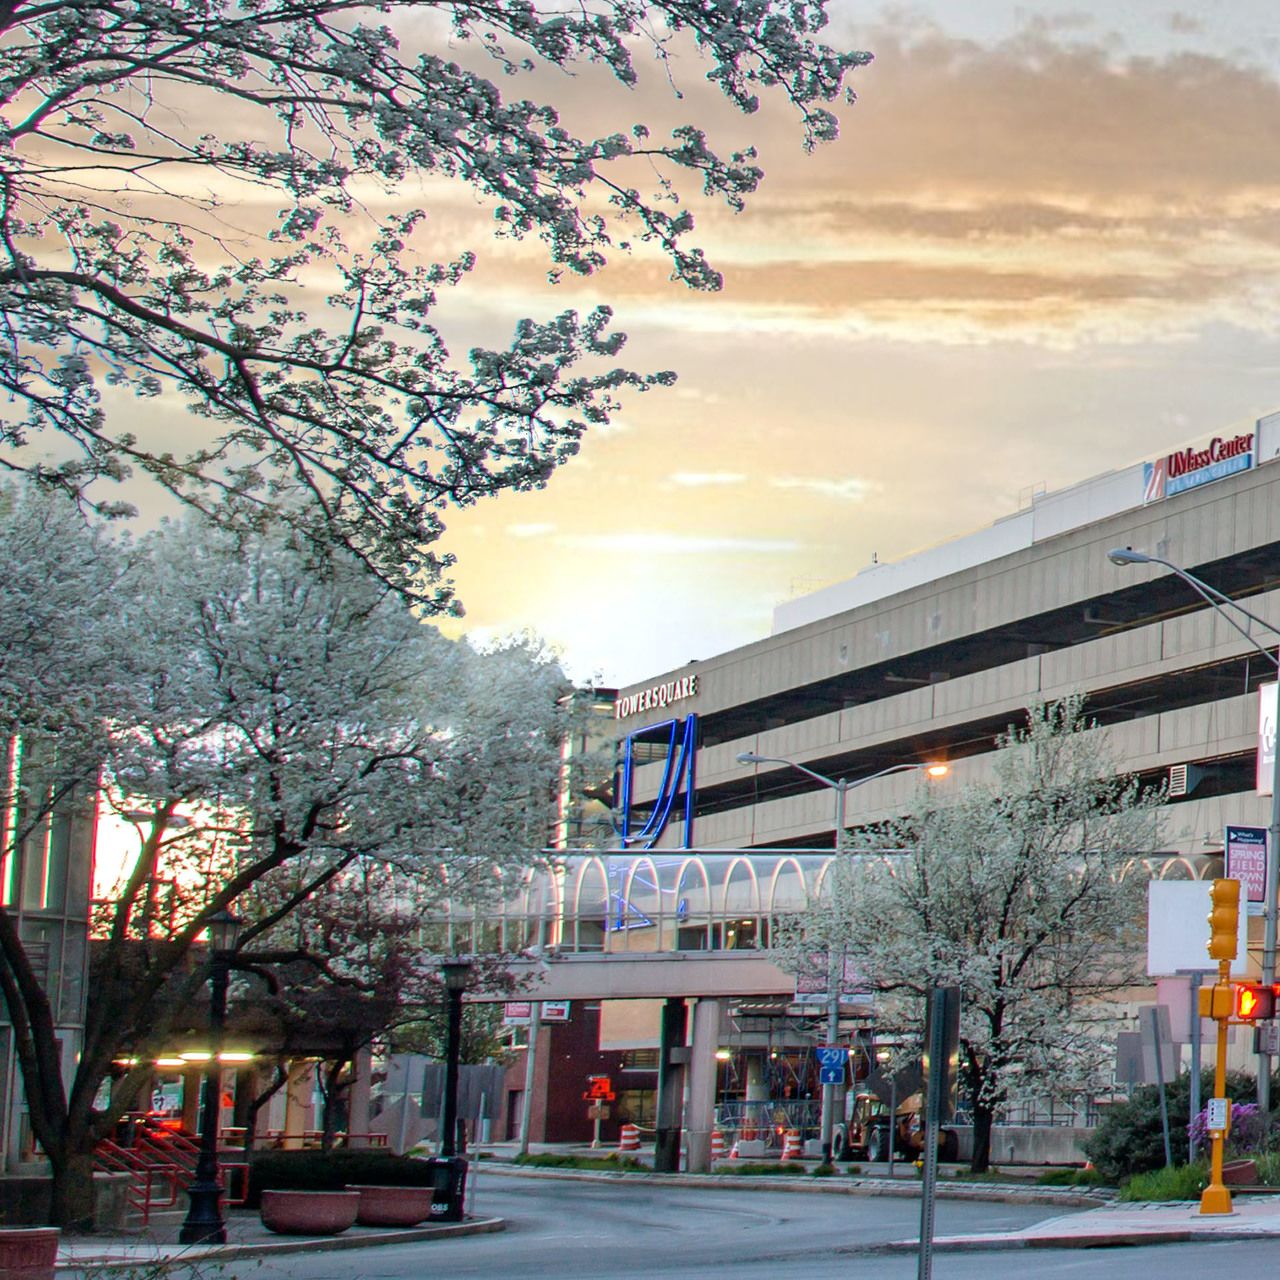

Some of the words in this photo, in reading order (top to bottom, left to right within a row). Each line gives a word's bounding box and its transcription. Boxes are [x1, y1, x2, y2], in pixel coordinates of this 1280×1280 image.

[614, 674, 697, 720] TOWERSQUARE
[1230, 849, 1265, 860] SPRING
[1230, 860, 1265, 871] FIELD
[822, 1049, 846, 1065] 291
